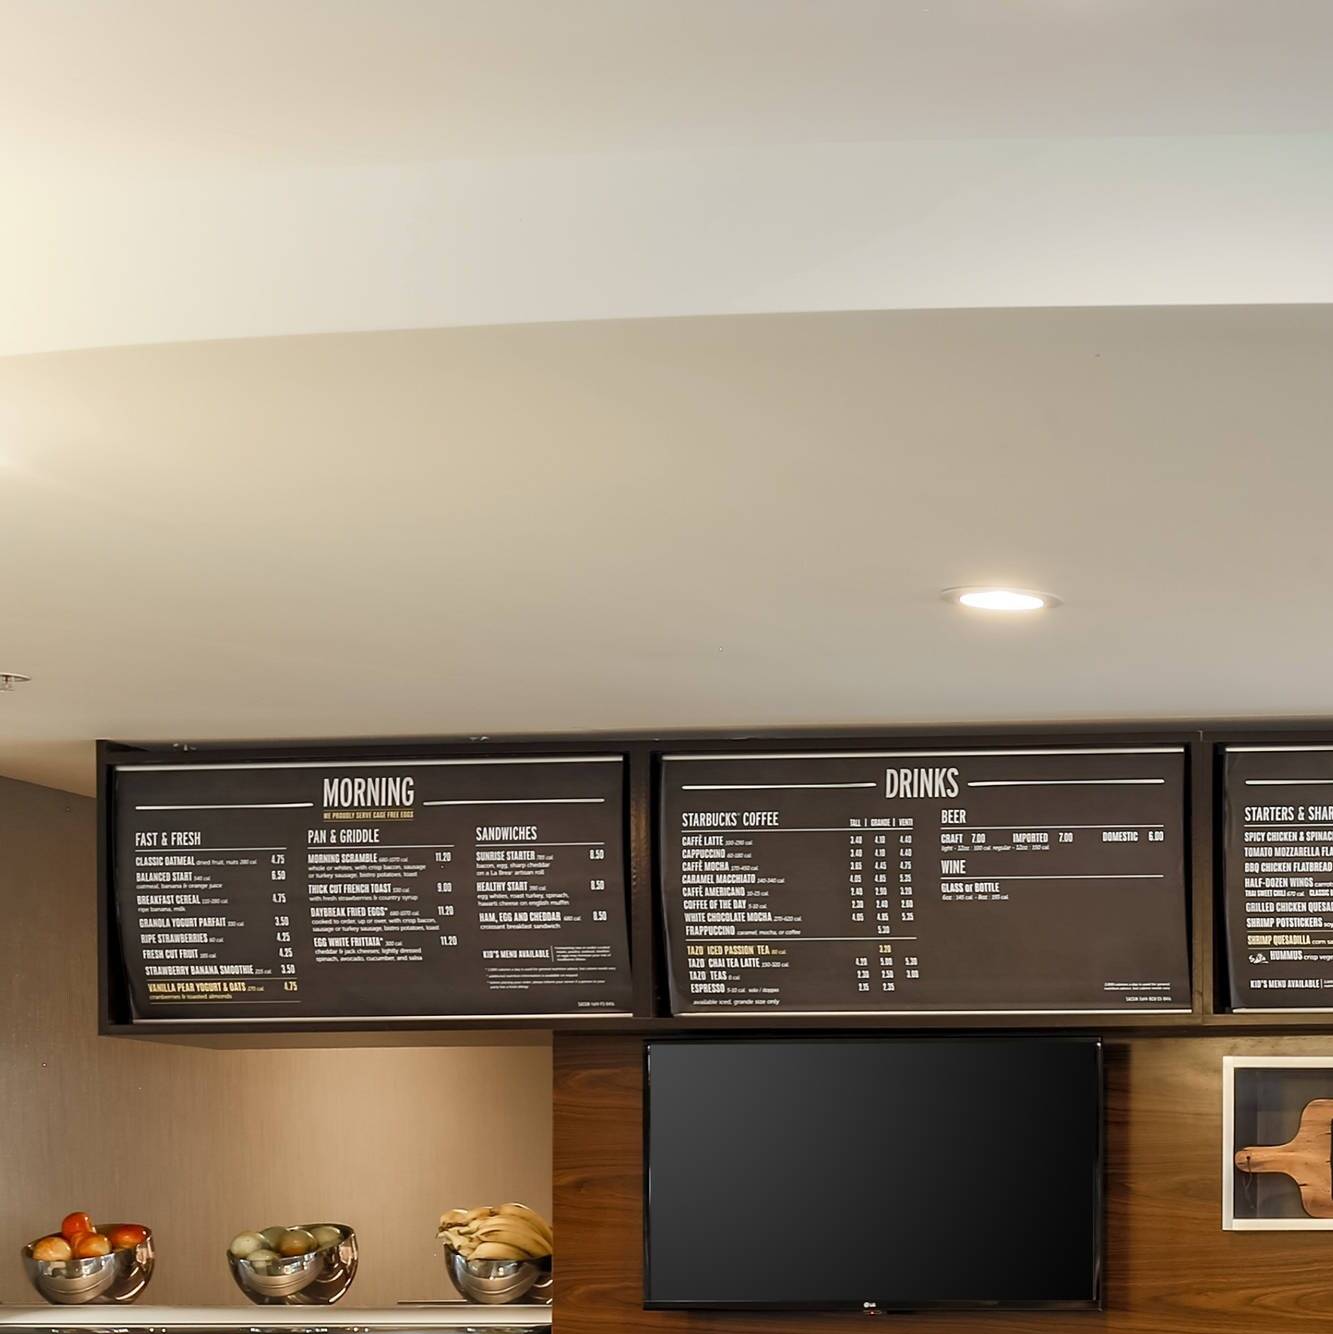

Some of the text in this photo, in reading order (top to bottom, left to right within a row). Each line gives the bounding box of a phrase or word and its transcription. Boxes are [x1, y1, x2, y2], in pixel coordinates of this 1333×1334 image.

[886, 768, 958, 798] DRINKS
[324, 777, 414, 807] MORNING
[743, 812, 778, 826] COFFEE
[942, 810, 966, 823] BEER
[1245, 807, 1294, 821] STARTERS
[1298, 807, 1304, 820] &
[308, 829, 379, 843] PAN & GRIDDLE
[476, 826, 537, 840] SANDWICHES
[1013, 833, 1048, 843] IMPORTED
[1059, 833, 1073, 842] 7.00
[1103, 832, 1138, 841] DOMESTIC
[1245, 832, 1265, 842] SPICY
[1267, 832, 1297, 841] CHICKEN
[1299, 832, 1304, 841] &
[136, 832, 200, 846] FAST & FRESH
[941, 834, 963, 843] CRAFT
[972, 834, 985, 843] 7.00
[1245, 847, 1272, 857] TOMATO
[1274, 847, 1320, 856] MOZZARELLA
[941, 860, 966, 874] WINE
[507, 882, 527, 891] START
[1245, 877, 1313, 887] HALF-DOZEN WINGS
[309, 885, 328, 894] THICK
[329, 884, 342, 893] CUT
[371, 884, 391, 893] TOAST
[941, 883, 963, 892] GLASS
[1246, 902, 1274, 912] GRILLED
[1276, 902, 1306, 912] CHICKEN
